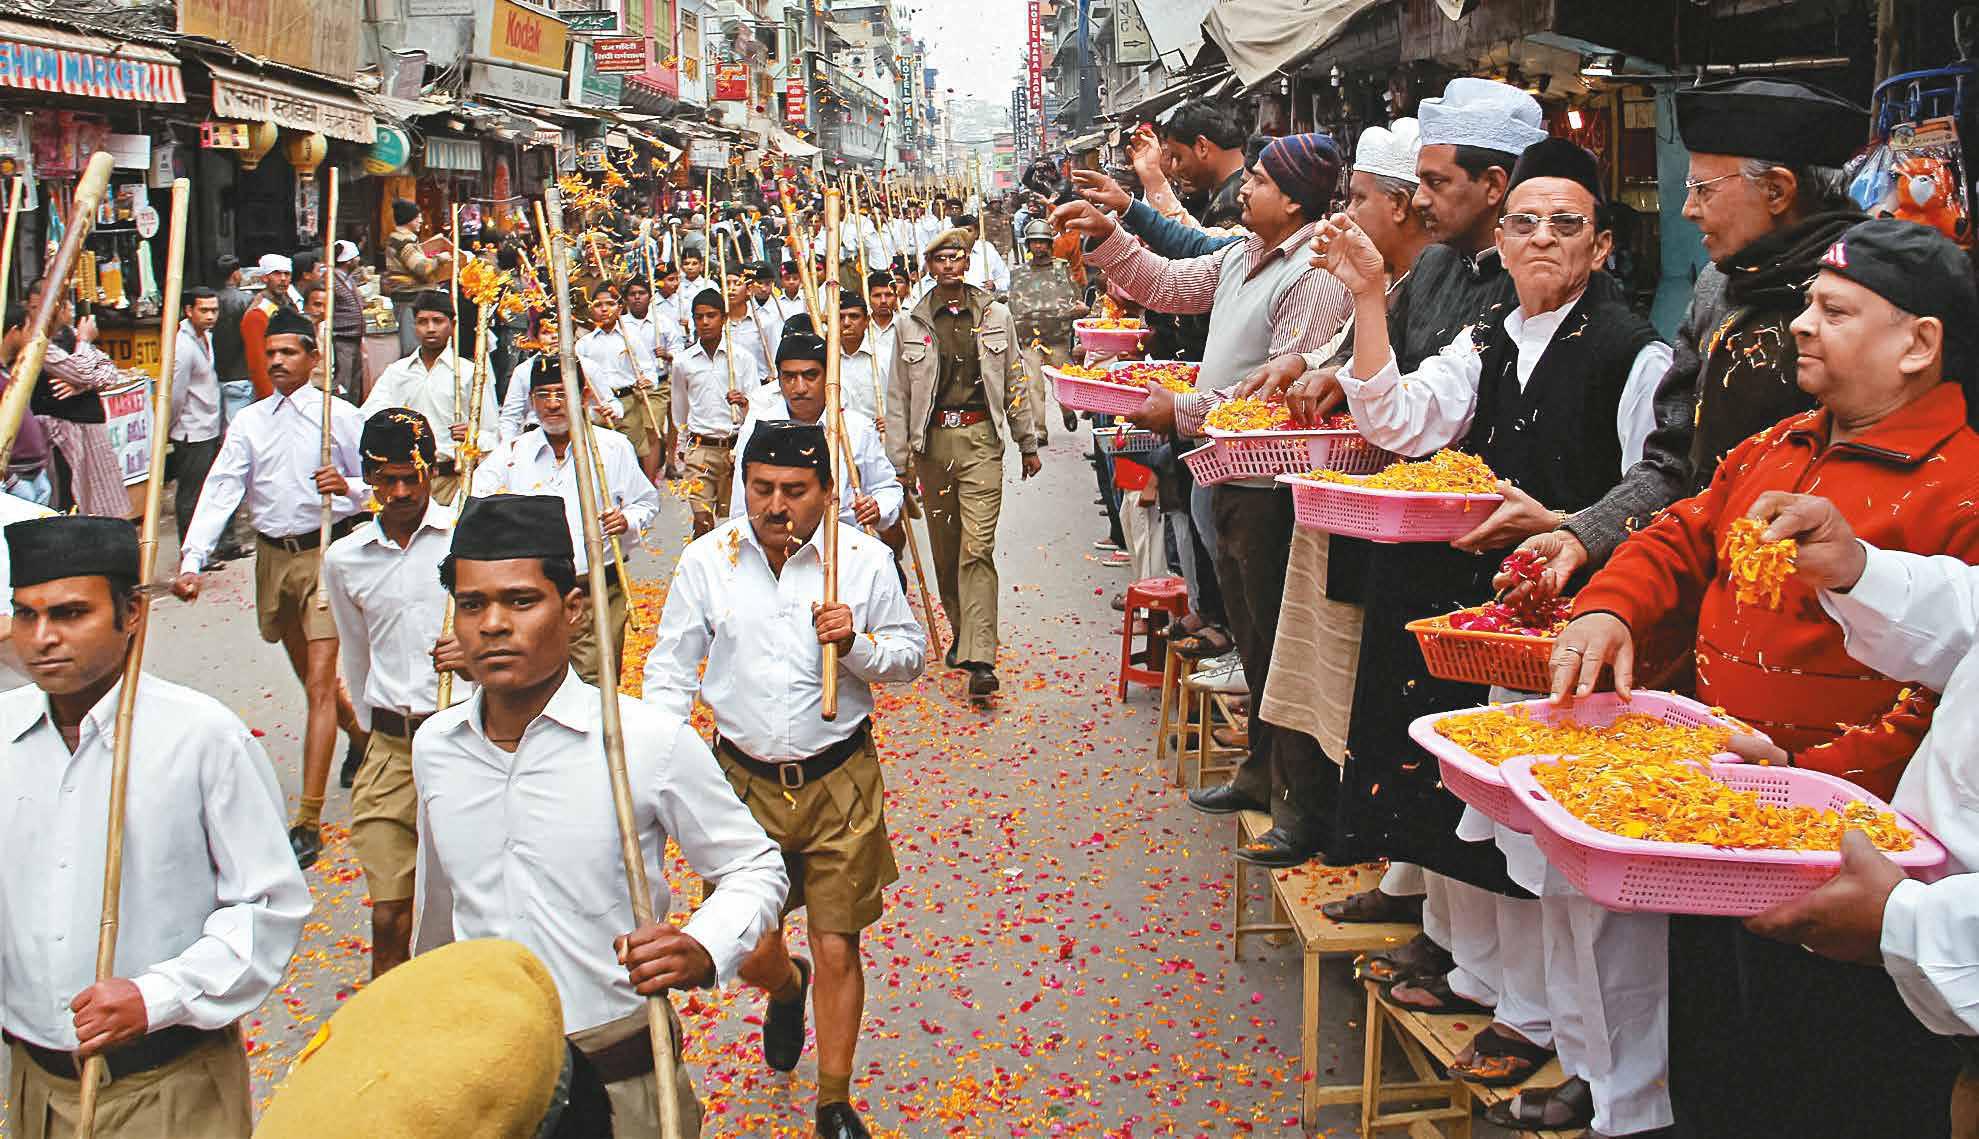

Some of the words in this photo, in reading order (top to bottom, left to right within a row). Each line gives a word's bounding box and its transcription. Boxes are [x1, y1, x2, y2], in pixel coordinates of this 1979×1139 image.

[506, 12, 542, 53] Kodak
[1030, 4, 1038, 39] HOTEL
[1031, 41, 1039, 69] BABA
[902, 57, 910, 97] HOTEL
